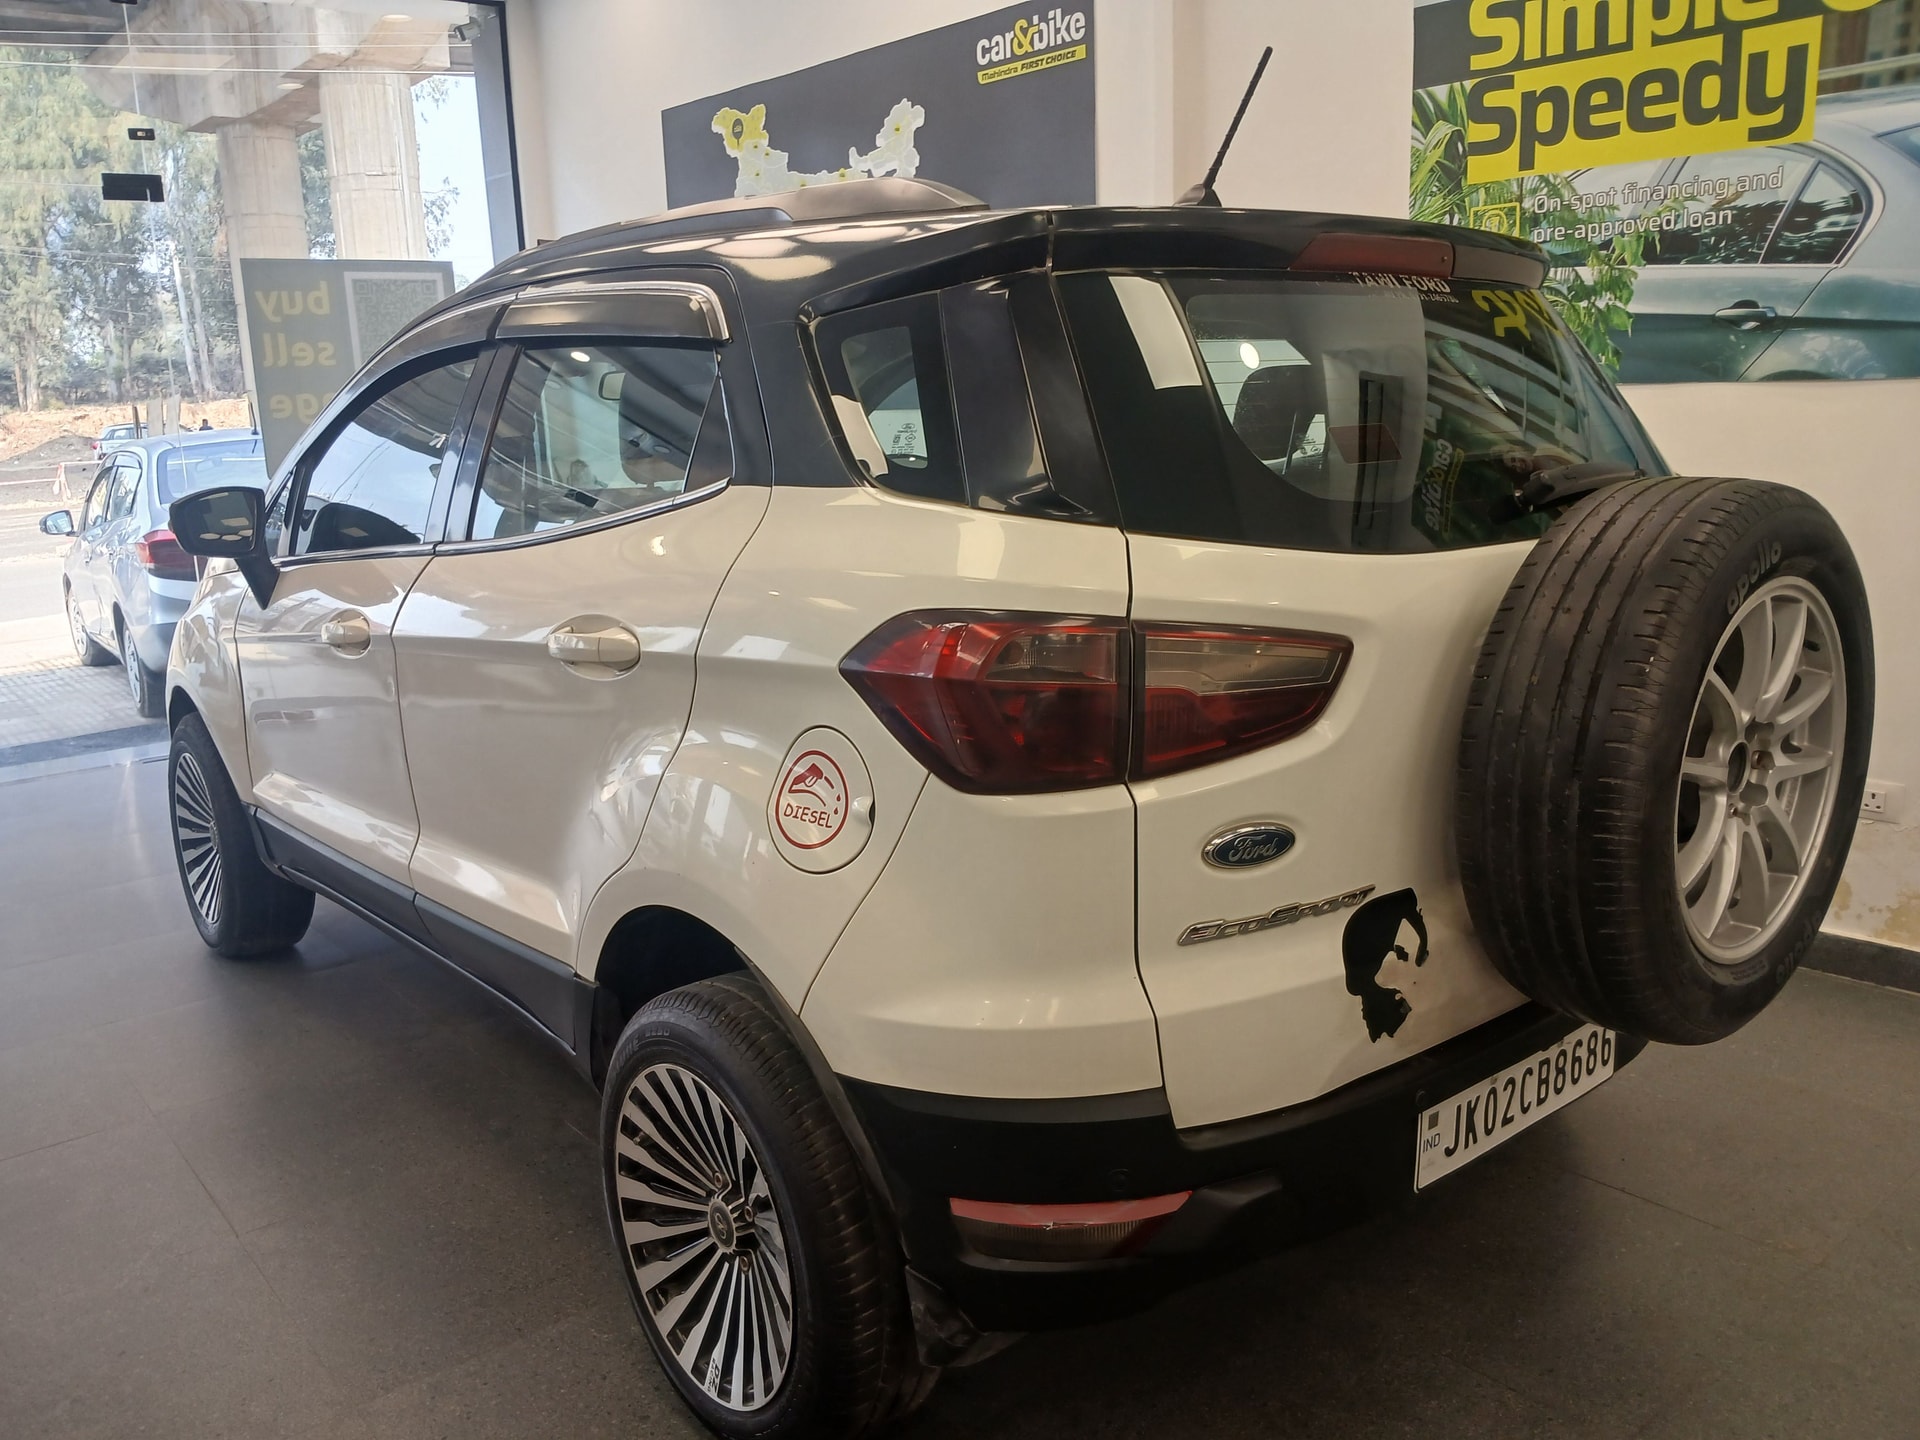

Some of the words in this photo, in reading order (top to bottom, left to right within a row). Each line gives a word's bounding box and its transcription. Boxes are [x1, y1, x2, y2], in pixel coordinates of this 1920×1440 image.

[976, 8, 1086, 66] car&bike
[981, 66, 1018, 81] Mahindra
[1020, 58, 1045, 72] FIRST
[1045, 50, 1077, 65] CHOICE
[1468, 31, 1810, 172] Speedy
[1534, 187, 1616, 214] On-spot
[1622, 175, 1730, 204] financing
[1737, 165, 1784, 192] and
[1532, 209, 1677, 244] pre-approved
[1682, 207, 1733, 228] loan
[1398, 274, 1451, 293] FORD
[1727, 539, 1781, 615] apollo
[784, 802, 832, 829] DIESEL
[1229, 834, 1279, 862] Ford
[1444, 1027, 1612, 1158] JK02CB8686
[1422, 1132, 1441, 1153] IND
